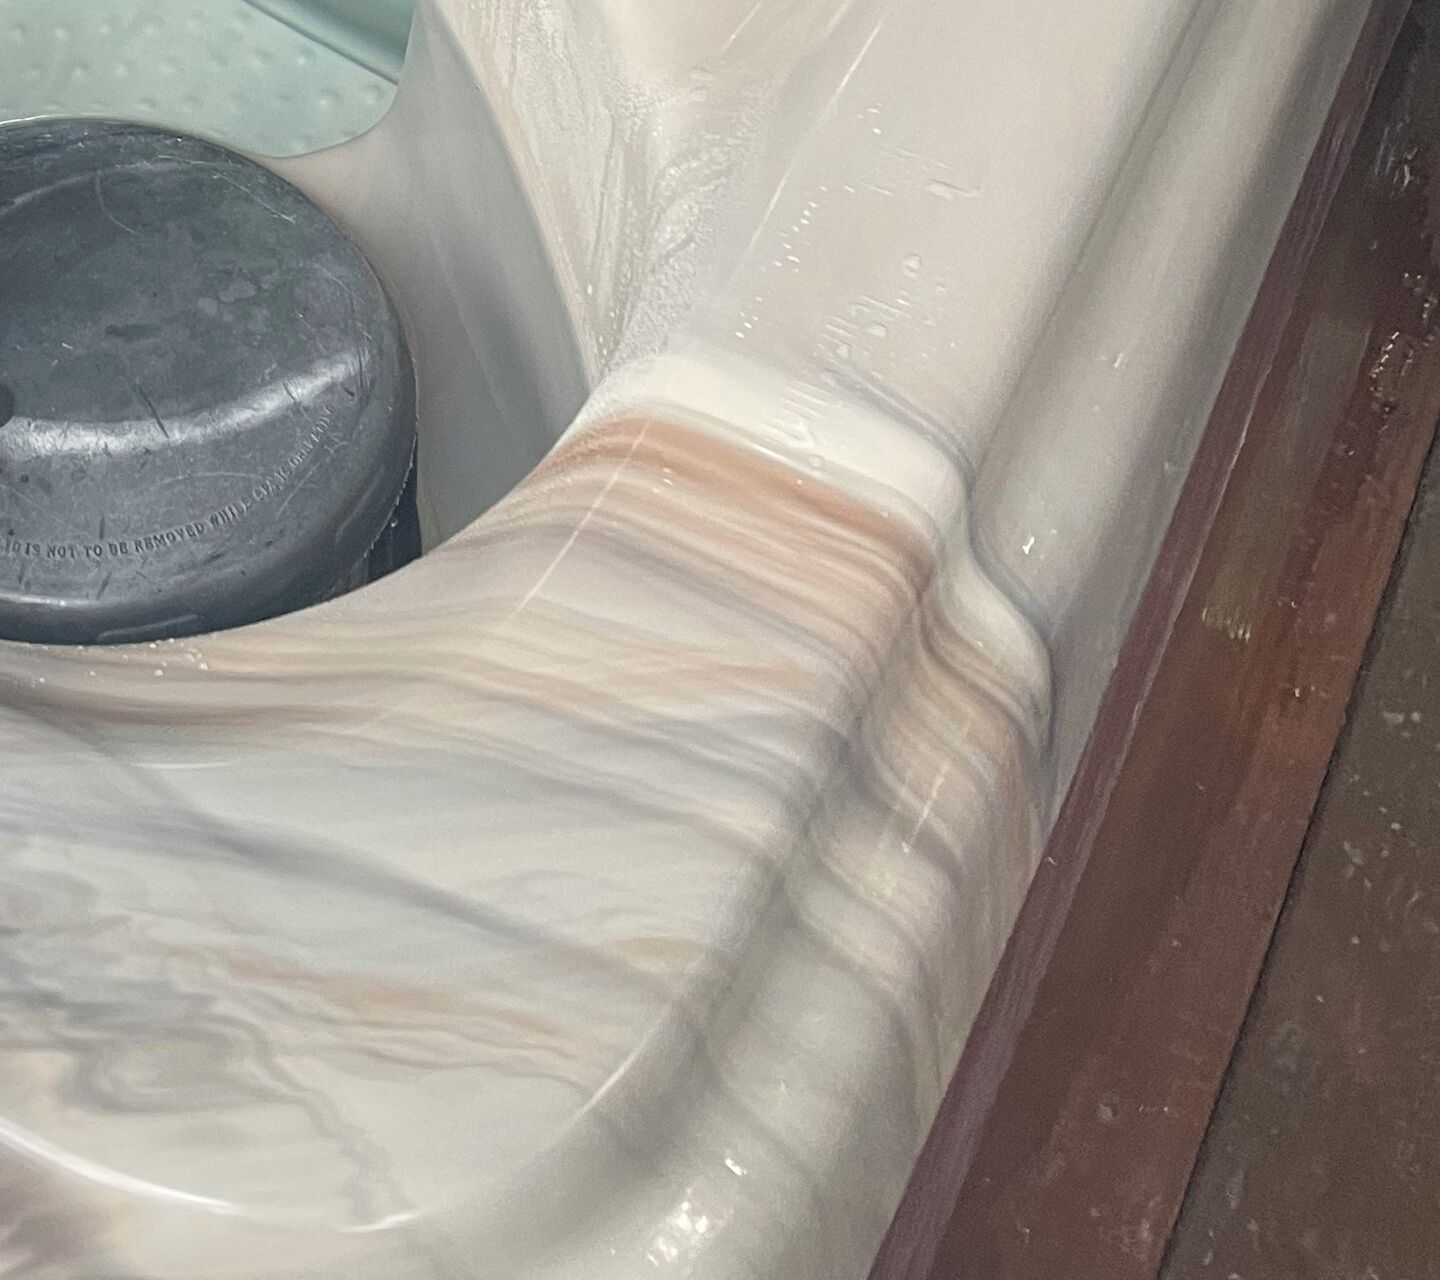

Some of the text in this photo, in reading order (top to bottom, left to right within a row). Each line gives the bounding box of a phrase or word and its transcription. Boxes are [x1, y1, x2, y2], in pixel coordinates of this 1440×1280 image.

[24, 542, 41, 556] IS
[47, 544, 76, 559] NOT
[83, 544, 103, 558] TO
[134, 521, 204, 553] REMOVED
